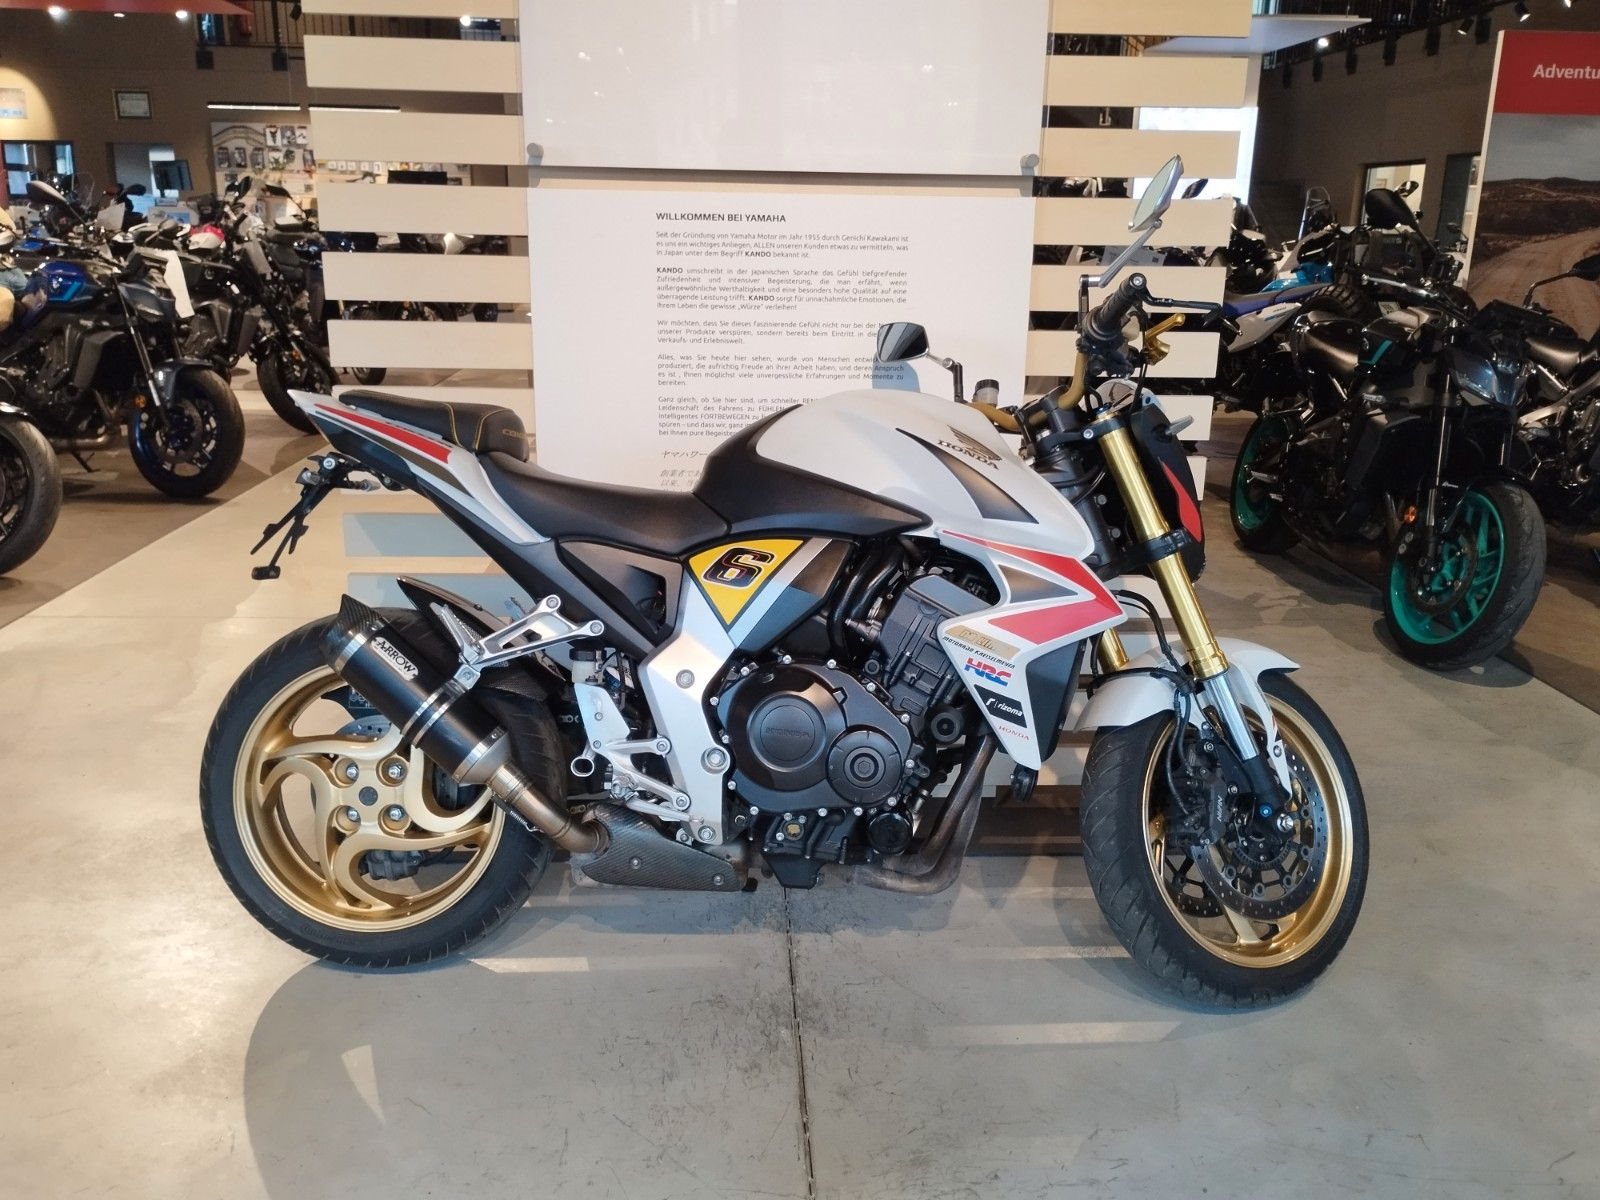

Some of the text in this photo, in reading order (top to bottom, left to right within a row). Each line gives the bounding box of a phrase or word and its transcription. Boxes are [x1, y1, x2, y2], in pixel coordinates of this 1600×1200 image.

[1532, 63, 1600, 79] Adventu
[656, 213, 725, 221] WILLKOMMEN
[745, 214, 787, 222] YAMAHA
[744, 250, 772, 258] KANDO
[656, 266, 684, 274] KANDO
[748, 294, 775, 302] KANDO
[938, 440, 1000, 470] HONDA
[376, 640, 416, 672] ARROW
[964, 657, 1012, 687] HRC
[997, 702, 1023, 717] rizoma
[998, 724, 1030, 741] HONDA
